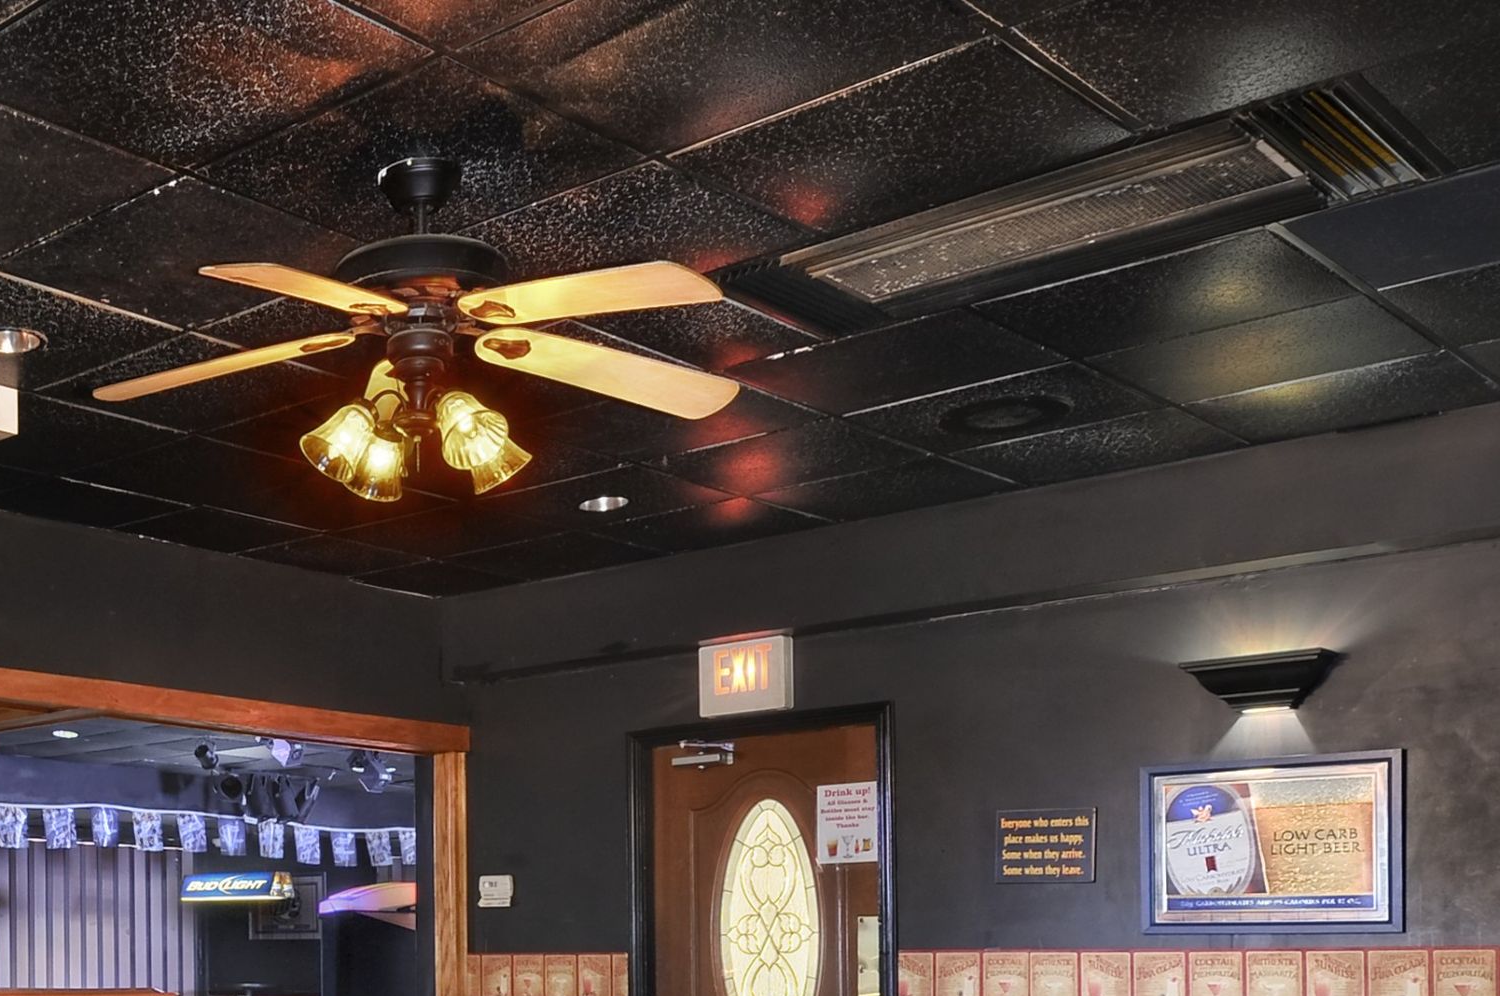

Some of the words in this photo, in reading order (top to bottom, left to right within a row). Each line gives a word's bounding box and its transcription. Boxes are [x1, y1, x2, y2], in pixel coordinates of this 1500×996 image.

[713, 643, 772, 695] EXIT
[824, 788, 853, 798] Drink
[855, 786, 871, 797] up!
[1000, 817, 1032, 832] Everyone
[1033, 816, 1049, 827] who
[1050, 818, 1074, 827] enters
[1074, 815, 1090, 827] this
[1003, 833, 1024, 847] place
[1024, 832, 1048, 844] makes
[1049, 834, 1059, 844] us
[1273, 830, 1311, 842] LOW
[1314, 827, 1358, 841] CARB
[1002, 848, 1022, 860] Some
[1022, 848, 1043, 860] when
[1043, 848, 1060, 862] they
[1061, 847, 1086, 859] arrive.
[1186, 842, 1232, 857] ULTRA
[1270, 842, 1318, 856] LIGHT
[1002, 864, 1023, 876] Some
[1024, 864, 1044, 876] when
[1044, 863, 1061, 878] they
[1061, 863, 1085, 875] leave.
[185, 880, 220, 892] BUD
[224, 879, 268, 890] LIGHT
[1194, 958, 1234, 967] COCKTAIL
[1439, 956, 1487, 966] COCKTAIL
